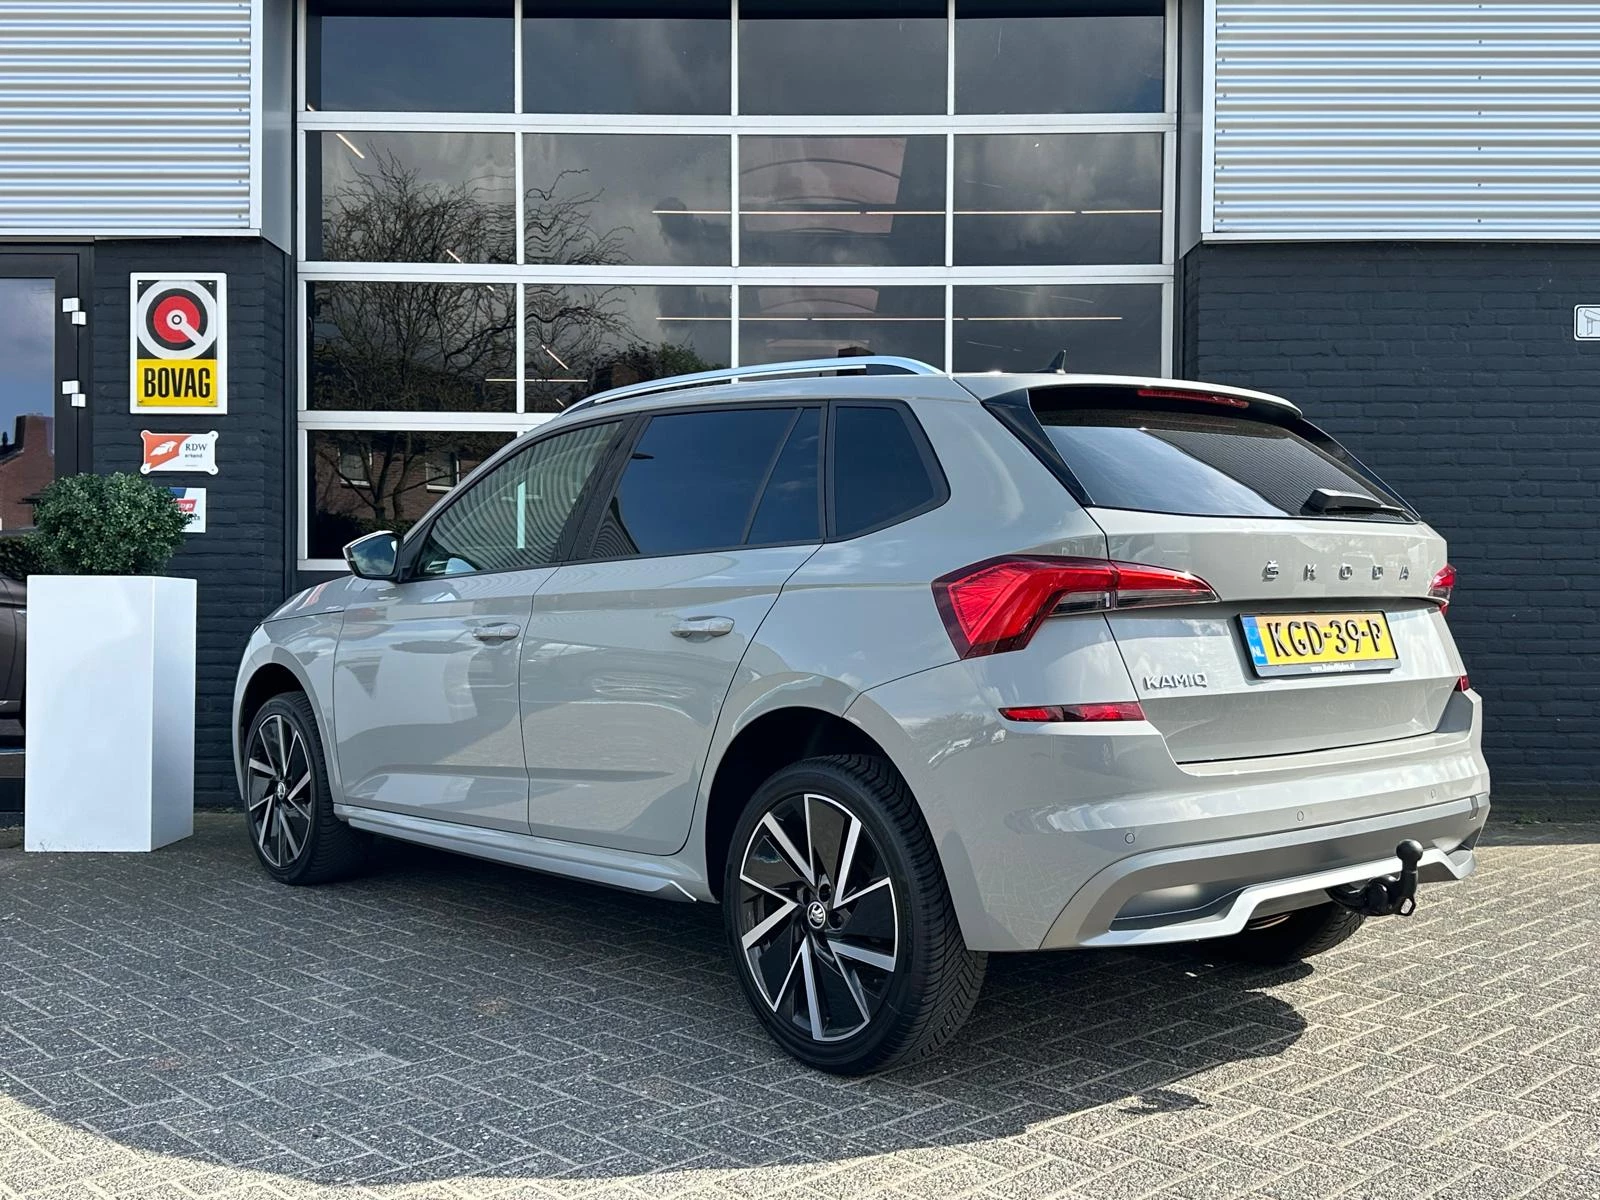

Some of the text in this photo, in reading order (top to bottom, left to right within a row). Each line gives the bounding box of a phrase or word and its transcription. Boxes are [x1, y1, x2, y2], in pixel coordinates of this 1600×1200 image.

[144, 367, 211, 398] BOVAG
[185, 443, 208, 451] RDW
[1262, 560, 1410, 582] ŠKODA
[1267, 619, 1383, 657] KGD-39-P
[1251, 646, 1264, 658] NL
[1142, 672, 1208, 691] KAMIQ
